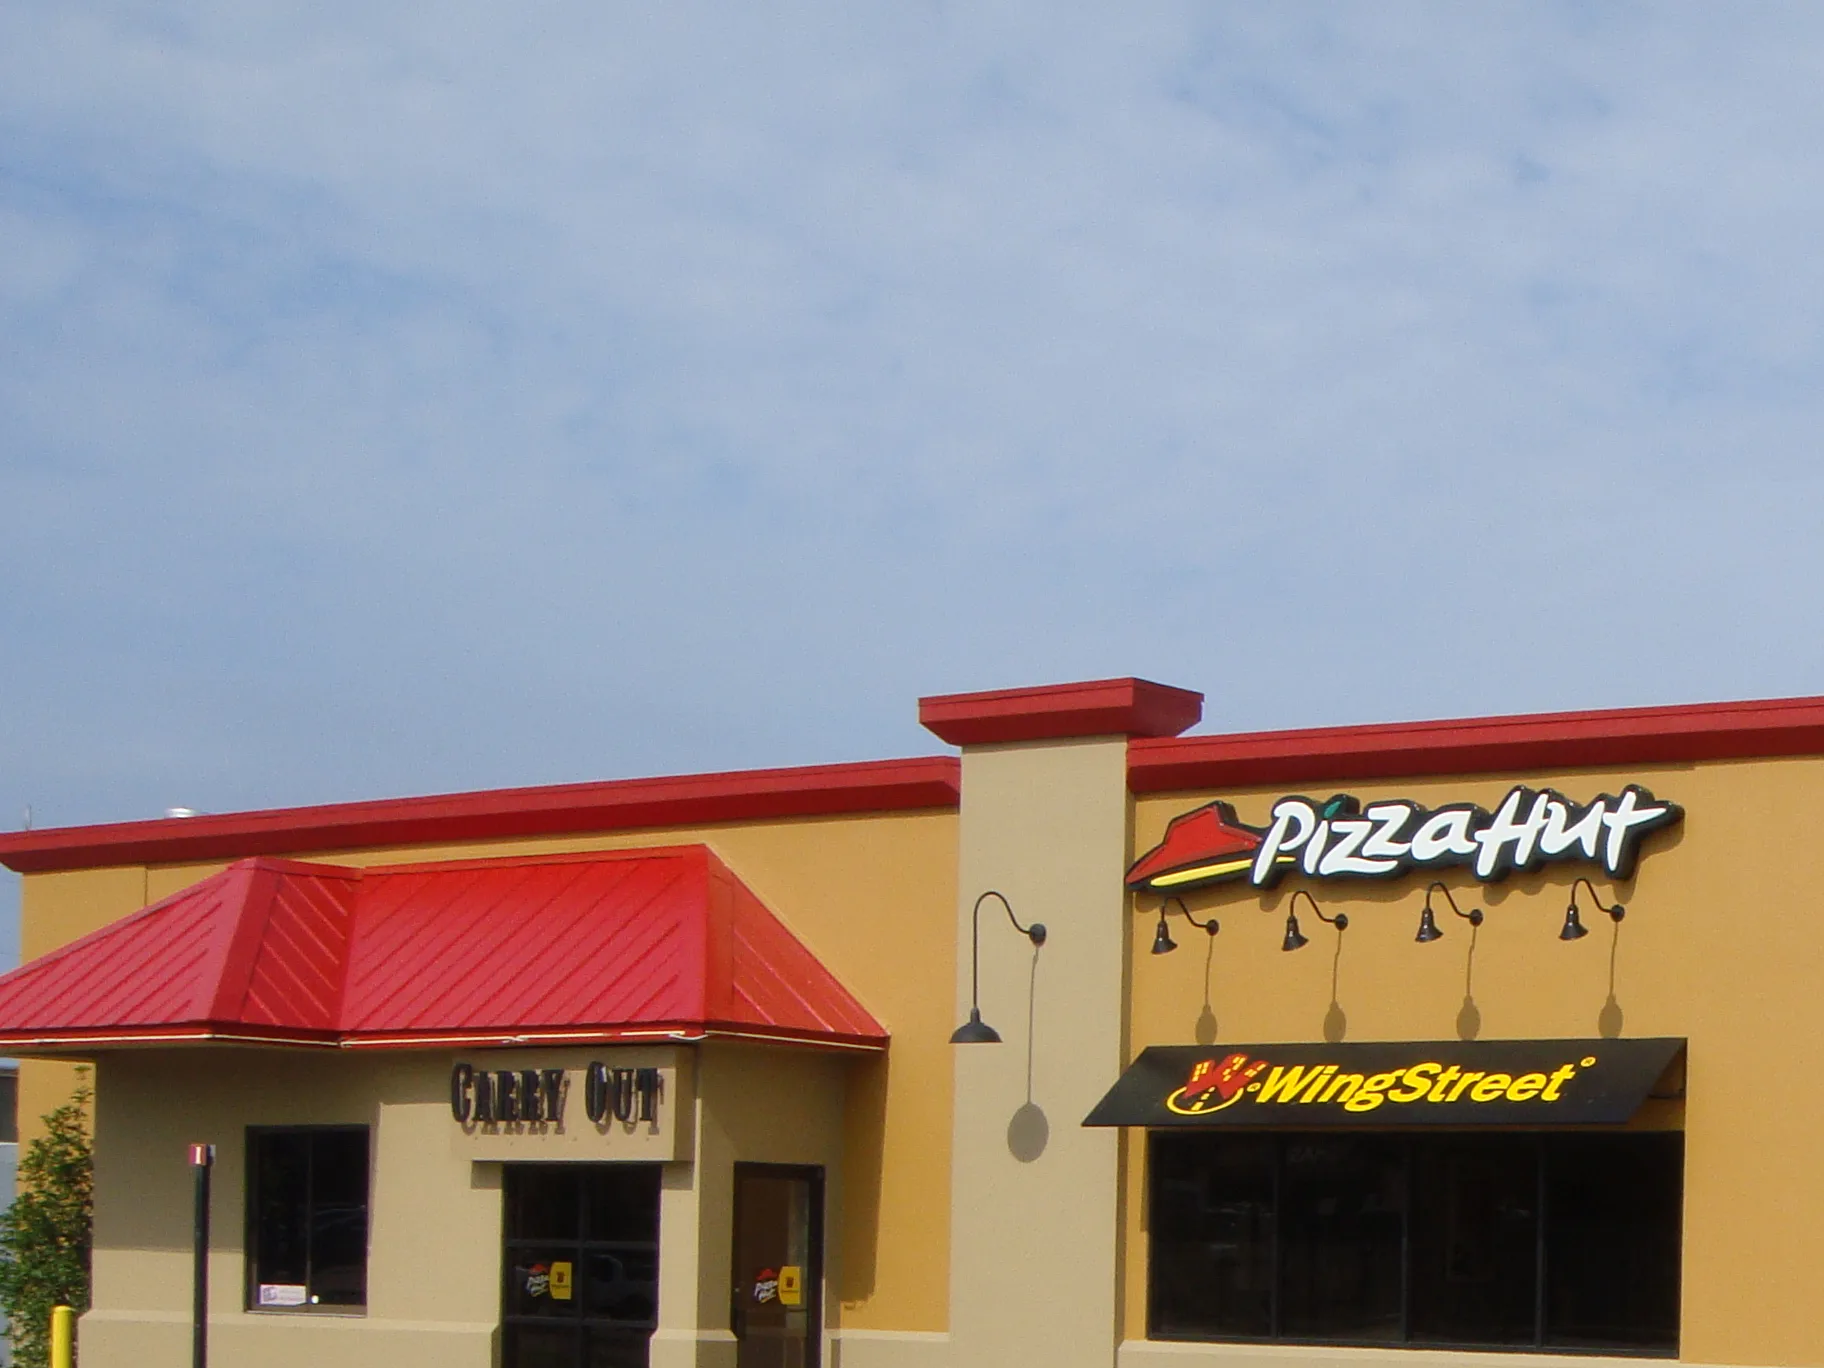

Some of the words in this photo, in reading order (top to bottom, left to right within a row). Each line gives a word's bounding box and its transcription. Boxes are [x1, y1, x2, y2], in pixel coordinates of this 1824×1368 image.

[1253, 799, 1477, 885] Pizza
[1474, 789, 1668, 877] Hut
[451, 1062, 566, 1124] CARRY
[585, 1060, 658, 1124] OUT
[1255, 1062, 1576, 1113] WingStreet
